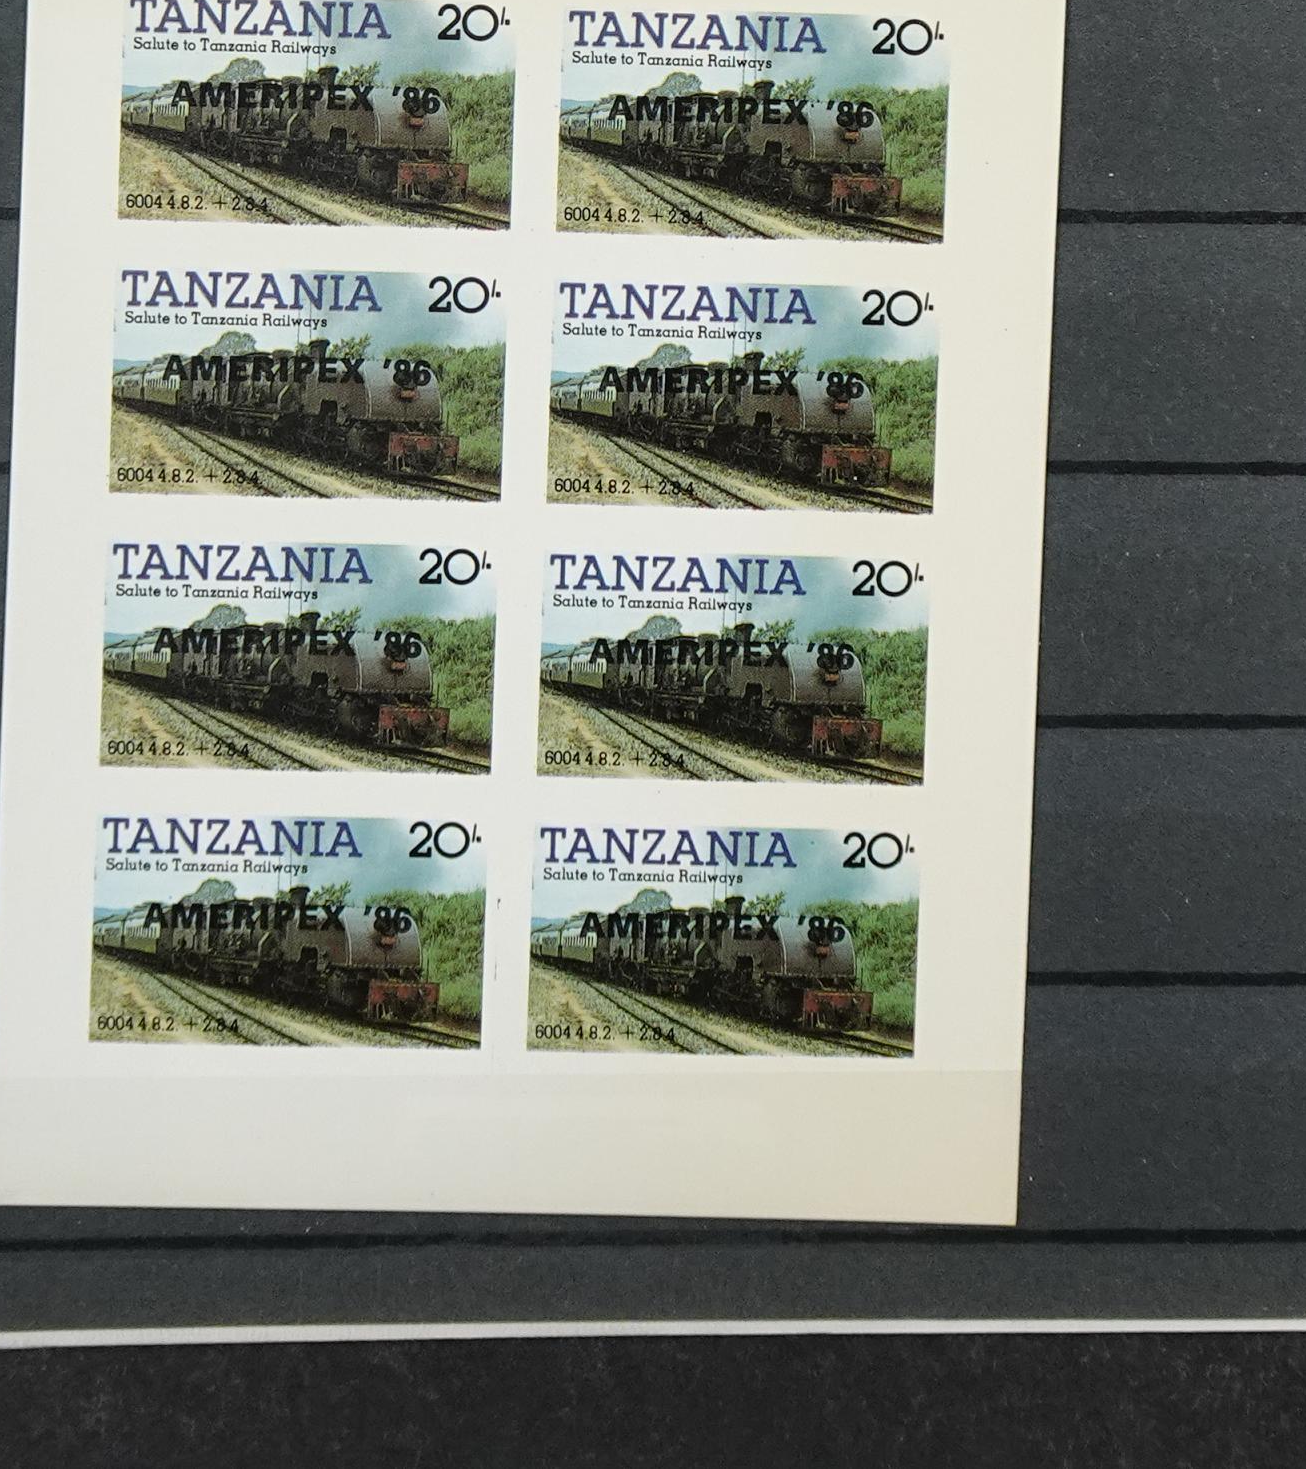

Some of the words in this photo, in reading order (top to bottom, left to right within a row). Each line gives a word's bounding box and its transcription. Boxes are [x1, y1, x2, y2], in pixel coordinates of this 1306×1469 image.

[569, 10, 826, 53] TANZANIA
[133, 37, 179, 51] Salute
[183, 39, 196, 51] to
[200, 38, 266, 54] Tanzania
[271, 41, 337, 56] Railways
[572, 51, 617, 65] Salute
[621, 53, 633, 65] to
[638, 52, 703, 68] Tanzania
[708, 56, 773, 70] Railways
[172, 81, 374, 112] AMERIPEX
[609, 95, 809, 126] AMERIPEX
[126, 194, 163, 209] 6004
[212, 196, 228, 211] +
[564, 207, 601, 223] 6004
[649, 209, 664, 224] +
[122, 269, 381, 312] TANZANIA
[559, 282, 816, 325] TANZANIA
[125, 311, 170, 325] Salute
[174, 312, 187, 324] to
[192, 312, 257, 327] Tanzania
[262, 315, 328, 329] Railways
[562, 323, 607, 336] Salute
[611, 324, 624, 336] to
[628, 324, 693, 339] Tanzania
[698, 327, 763, 342] Railways
[163, 354, 365, 385] AMERIPEX
[600, 366, 799, 397] AMERIPEX
[117, 468, 155, 483] 6004
[204, 469, 219, 484] +
[554, 478, 591, 494] 6004
[639, 480, 655, 495] +
[113, 542, 372, 584] TANZANIA
[549, 553, 806, 596] TANZANIA
[116, 584, 161, 597] Salute
[165, 585, 178, 597] to
[183, 584, 248, 599] Tanzania
[253, 587, 318, 602] Railways
[552, 594, 597, 608] Salute
[601, 596, 614, 608] to
[618, 595, 683, 610] Tanzania
[688, 598, 753, 613] Railways
[154, 627, 356, 657] AMERIPEX
[590, 638, 790, 668] AMERIPEX
[108, 741, 145, 756] 6004
[194, 742, 210, 757] +
[545, 751, 582, 766] 6004
[630, 753, 645, 768] +
[103, 816, 362, 858] TANZANIA
[540, 826, 796, 868] TANZANIA
[105, 858, 151, 872] Salute
[155, 860, 168, 872] to
[172, 859, 238, 874] Tanzania
[243, 861, 308, 876] Railways
[543, 868, 588, 882] Salute
[592, 869, 604, 881] to
[609, 868, 674, 883] Tanzania
[679, 871, 743, 886] Railways
[143, 902, 346, 932] AMERIPEX
[580, 911, 780, 941] AMERIPEX
[97, 1017, 135, 1032] 6004
[184, 1018, 199, 1033] +
[535, 1025, 572, 1040] 6004
[620, 1026, 635, 1041] +
